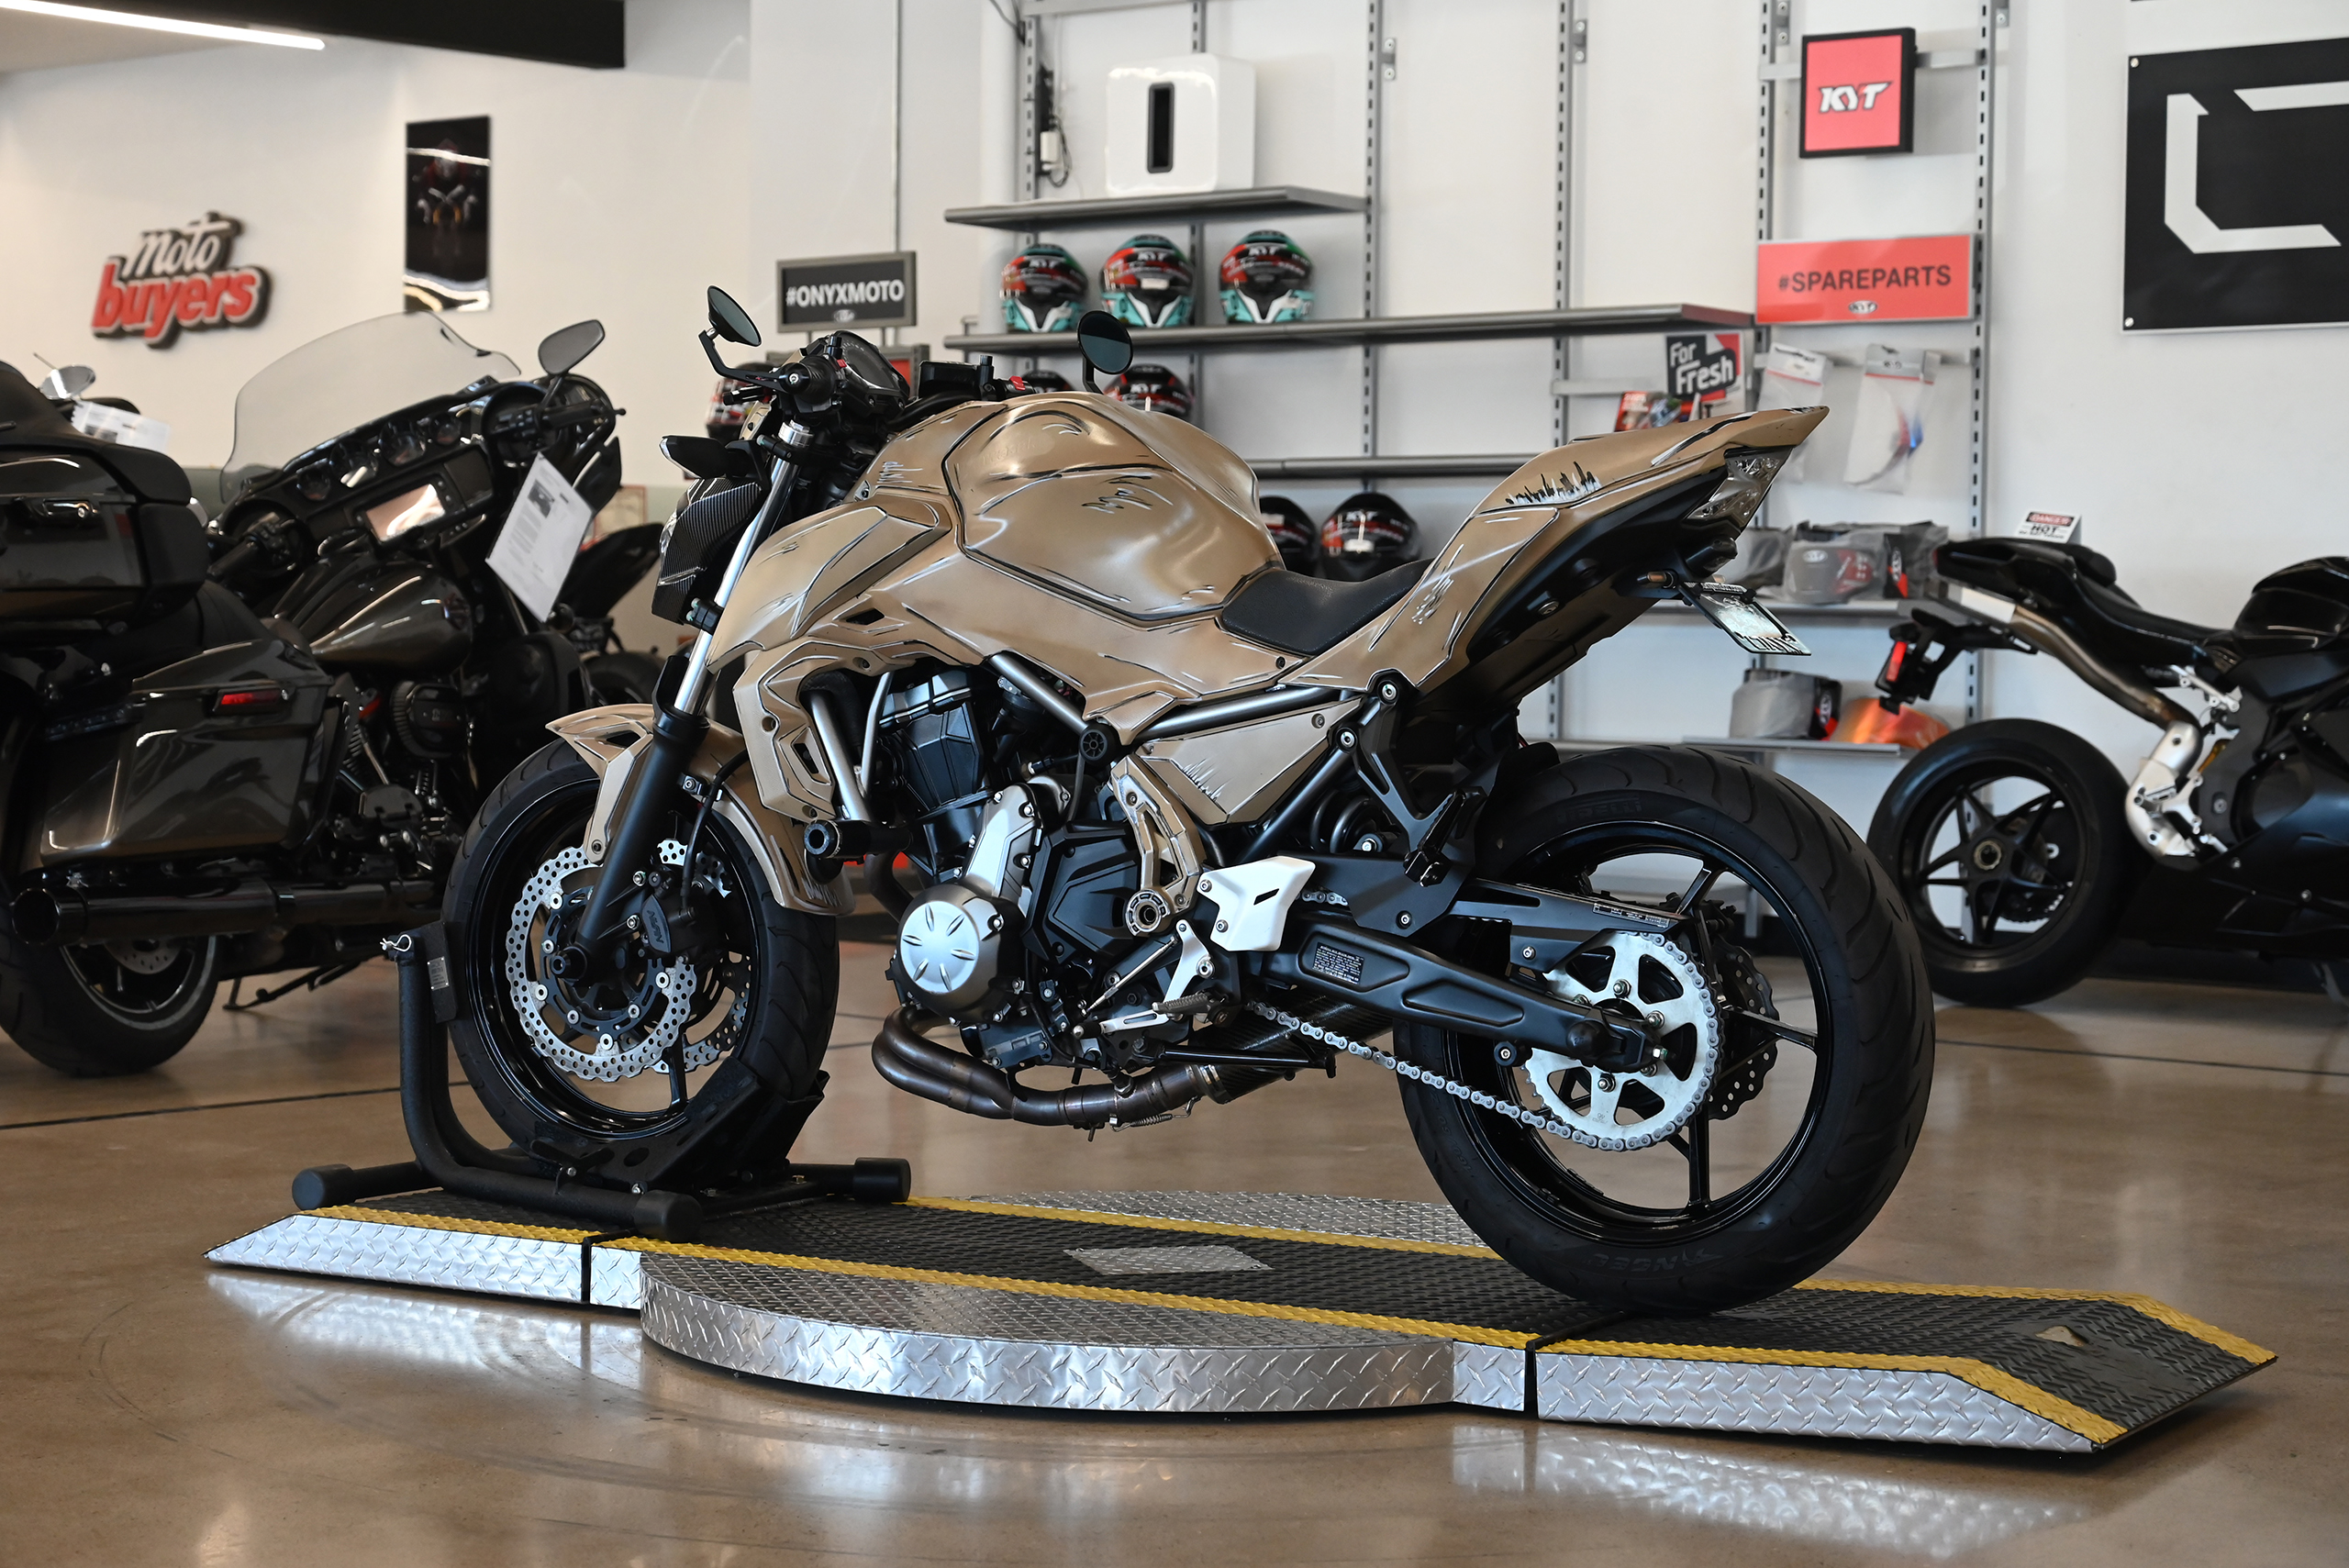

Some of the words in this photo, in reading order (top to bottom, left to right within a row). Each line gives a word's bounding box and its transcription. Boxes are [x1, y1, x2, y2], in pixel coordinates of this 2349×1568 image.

[1819, 81, 1893, 113] KYT
[785, 279, 905, 307] #ONYXMOTO
[1778, 265, 1952, 293] #SPAREPARTS
[92, 261, 257, 339] buyers
[1669, 340, 1697, 367] For
[1675, 354, 1734, 395] Fresh
